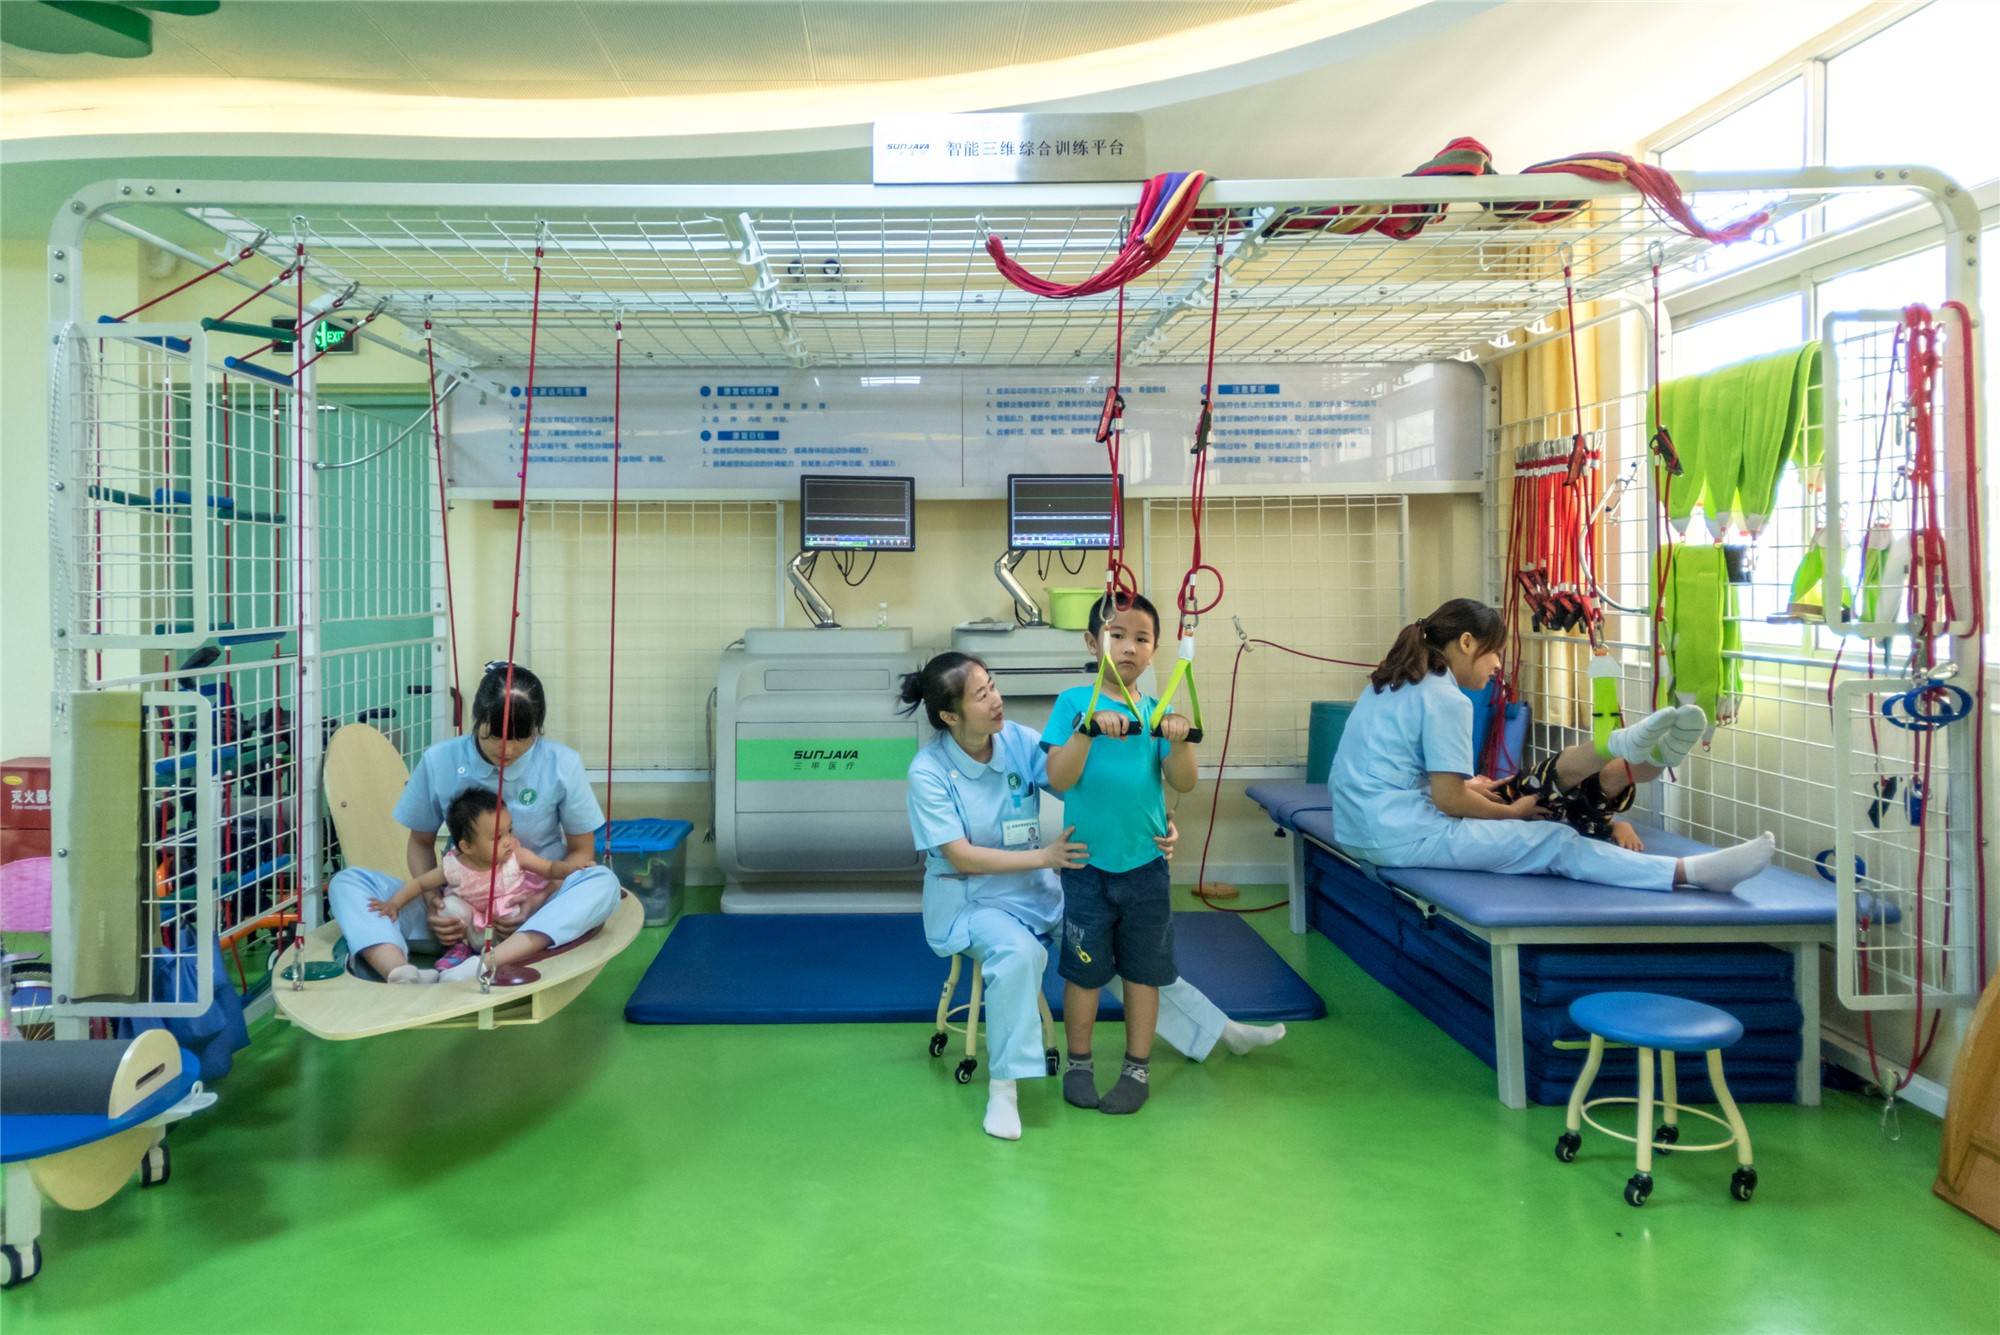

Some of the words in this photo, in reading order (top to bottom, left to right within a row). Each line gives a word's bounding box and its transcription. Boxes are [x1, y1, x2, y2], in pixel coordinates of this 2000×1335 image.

[946, 138, 1125, 157] 智能三维综合训练平台
[793, 750, 859, 760] SUNJAVA
